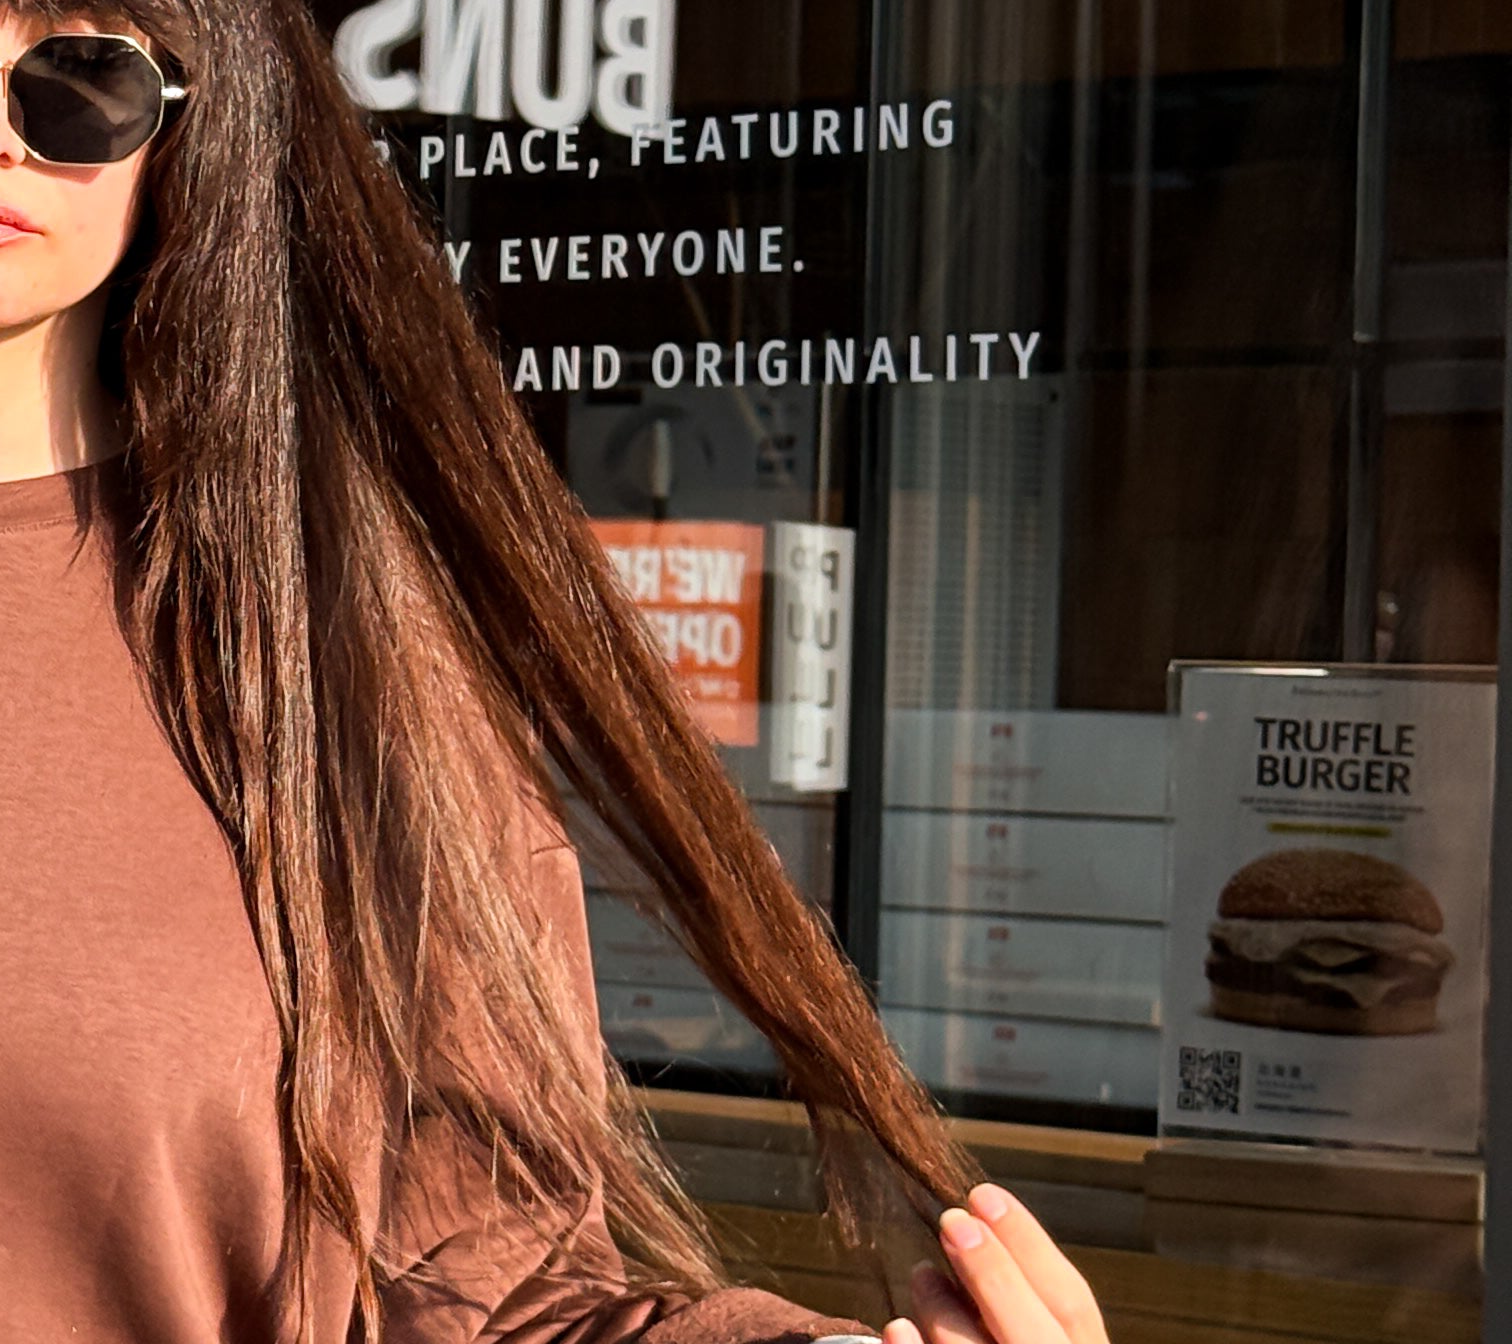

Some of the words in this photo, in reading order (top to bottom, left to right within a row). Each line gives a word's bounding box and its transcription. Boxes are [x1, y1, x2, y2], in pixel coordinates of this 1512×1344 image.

[419, 125, 600, 180] PLACE,
[630, 100, 954, 167] FEATURING
[499, 226, 805, 284] EVERYONE.
[512, 344, 622, 393] AND
[651, 331, 1041, 389] ORIGINALITY
[1254, 716, 1417, 757] TRUFFLE
[1256, 753, 1411, 796] BURGER
